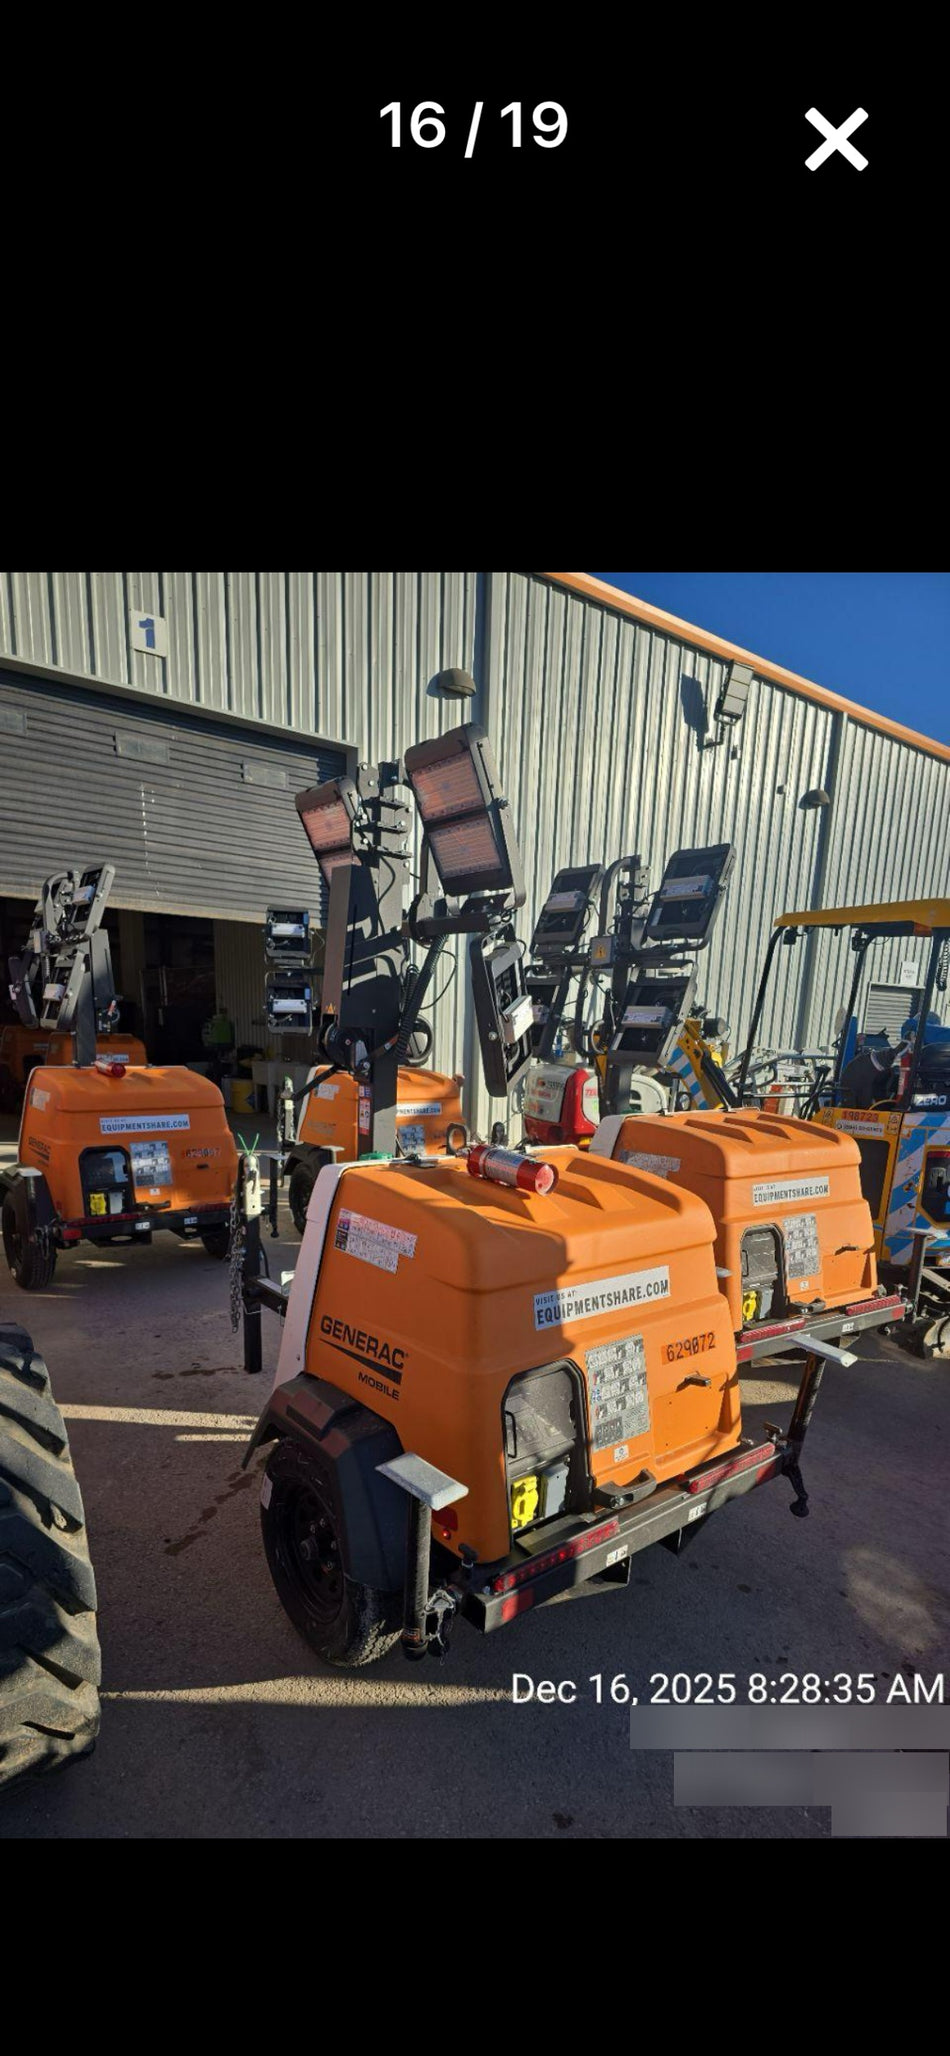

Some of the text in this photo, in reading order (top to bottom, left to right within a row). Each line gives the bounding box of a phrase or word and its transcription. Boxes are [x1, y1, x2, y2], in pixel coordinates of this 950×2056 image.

[138, 617, 156, 650] 1
[915, 1095, 947, 1107] ZERO
[101, 1120, 189, 1132] EQUIPMENTSHARE.COM
[754, 1185, 829, 1203] EQUIPMENTSHARE.COM
[535, 1294, 555, 1306] VISIT
[556, 1292, 565, 1302] US
[537, 1279, 669, 1325] EQUIPMENTSHARE.COM
[320, 1315, 404, 1369] GENERAC
[667, 1331, 716, 1362] 629072
[358, 1371, 400, 1401] MOBILE
